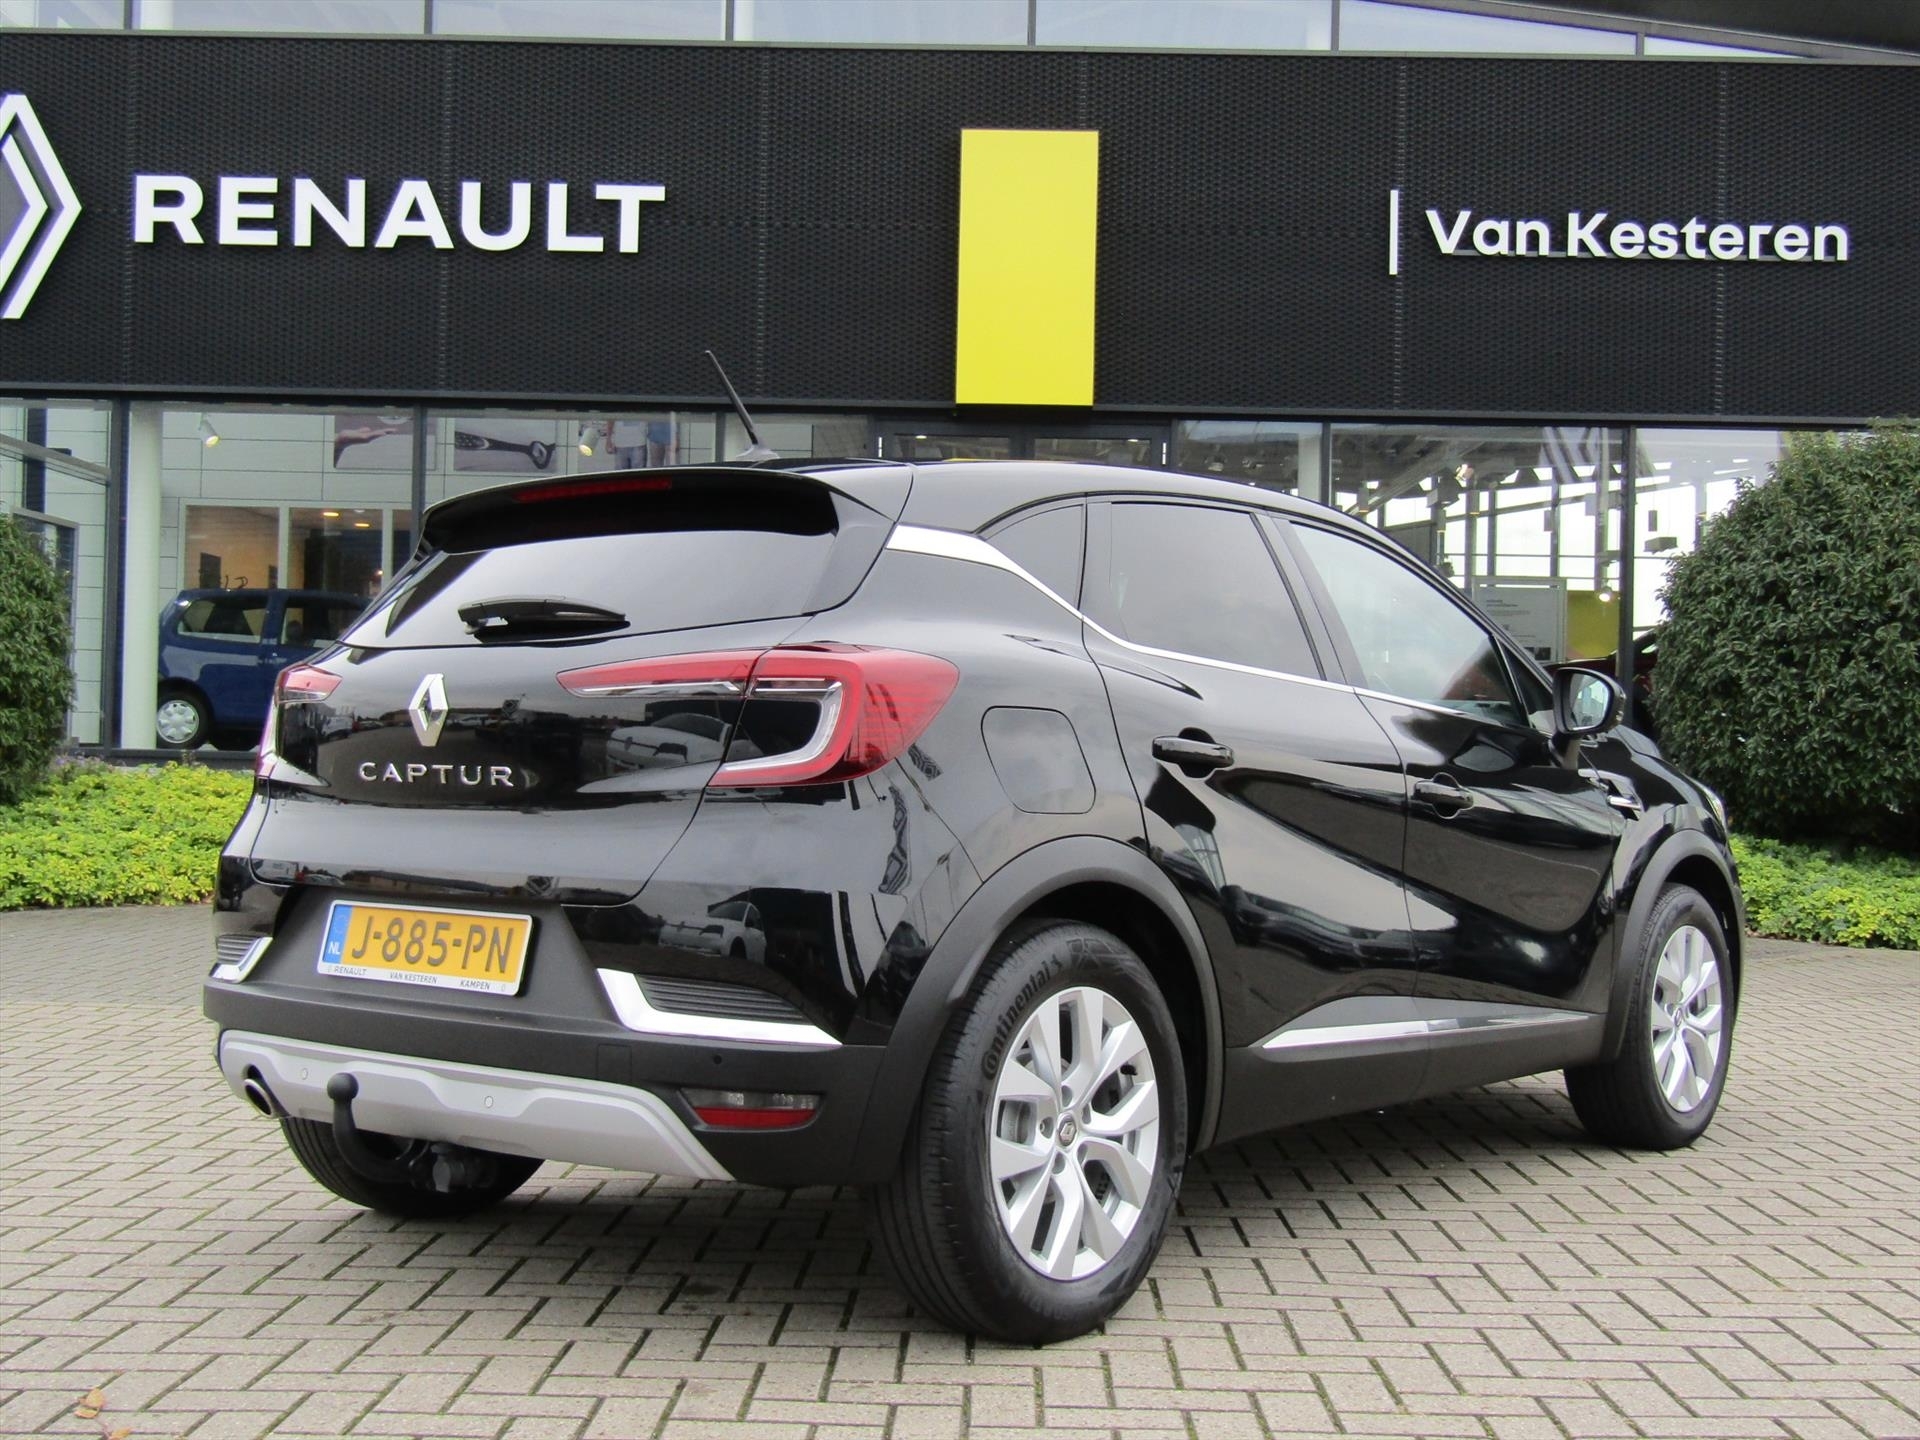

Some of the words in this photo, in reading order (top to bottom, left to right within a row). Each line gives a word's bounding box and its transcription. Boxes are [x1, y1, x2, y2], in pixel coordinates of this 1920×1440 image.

[133, 174, 666, 253] RENAULT
[1425, 209, 1550, 256] Van
[1566, 212, 1848, 262] Kesteren
[358, 761, 514, 788] CAPTUR
[327, 941, 341, 955] NL
[351, 915, 515, 974] J-885-PN
[333, 965, 368, 976] RENAULT
[389, 971, 403, 981] VAN
[404, 973, 438, 985] KESTEREN
[460, 980, 491, 991] KAMPEN
[981, 959, 1052, 1081] Continental
